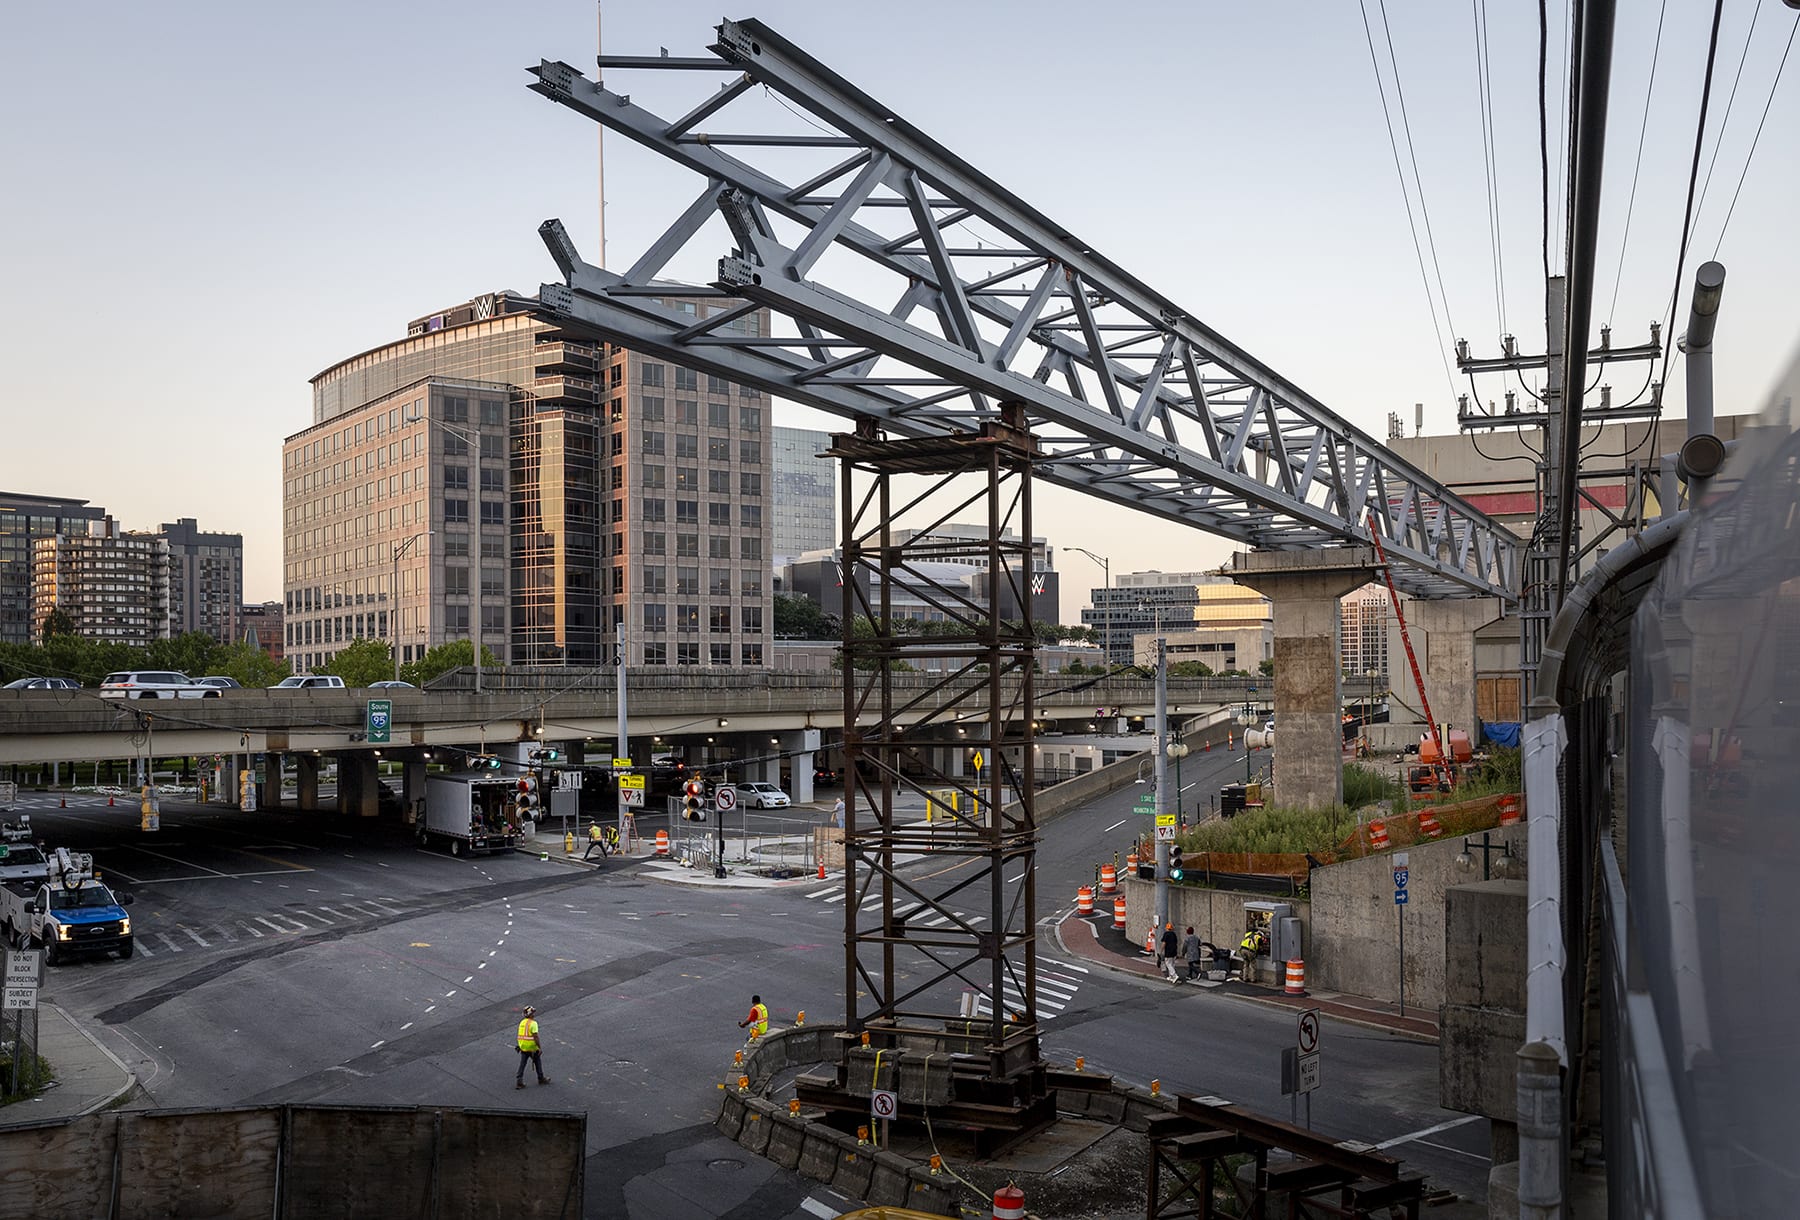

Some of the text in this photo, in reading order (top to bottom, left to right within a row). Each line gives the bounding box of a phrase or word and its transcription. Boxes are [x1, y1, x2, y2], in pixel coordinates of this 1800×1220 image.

[373, 716, 386, 725] 95
[1395, 873, 1407, 884] 95
[19, 999, 31, 1007] FINE
[1301, 1061, 1318, 1074] NO LEFT
[1304, 1075, 1315, 1085] TURN
